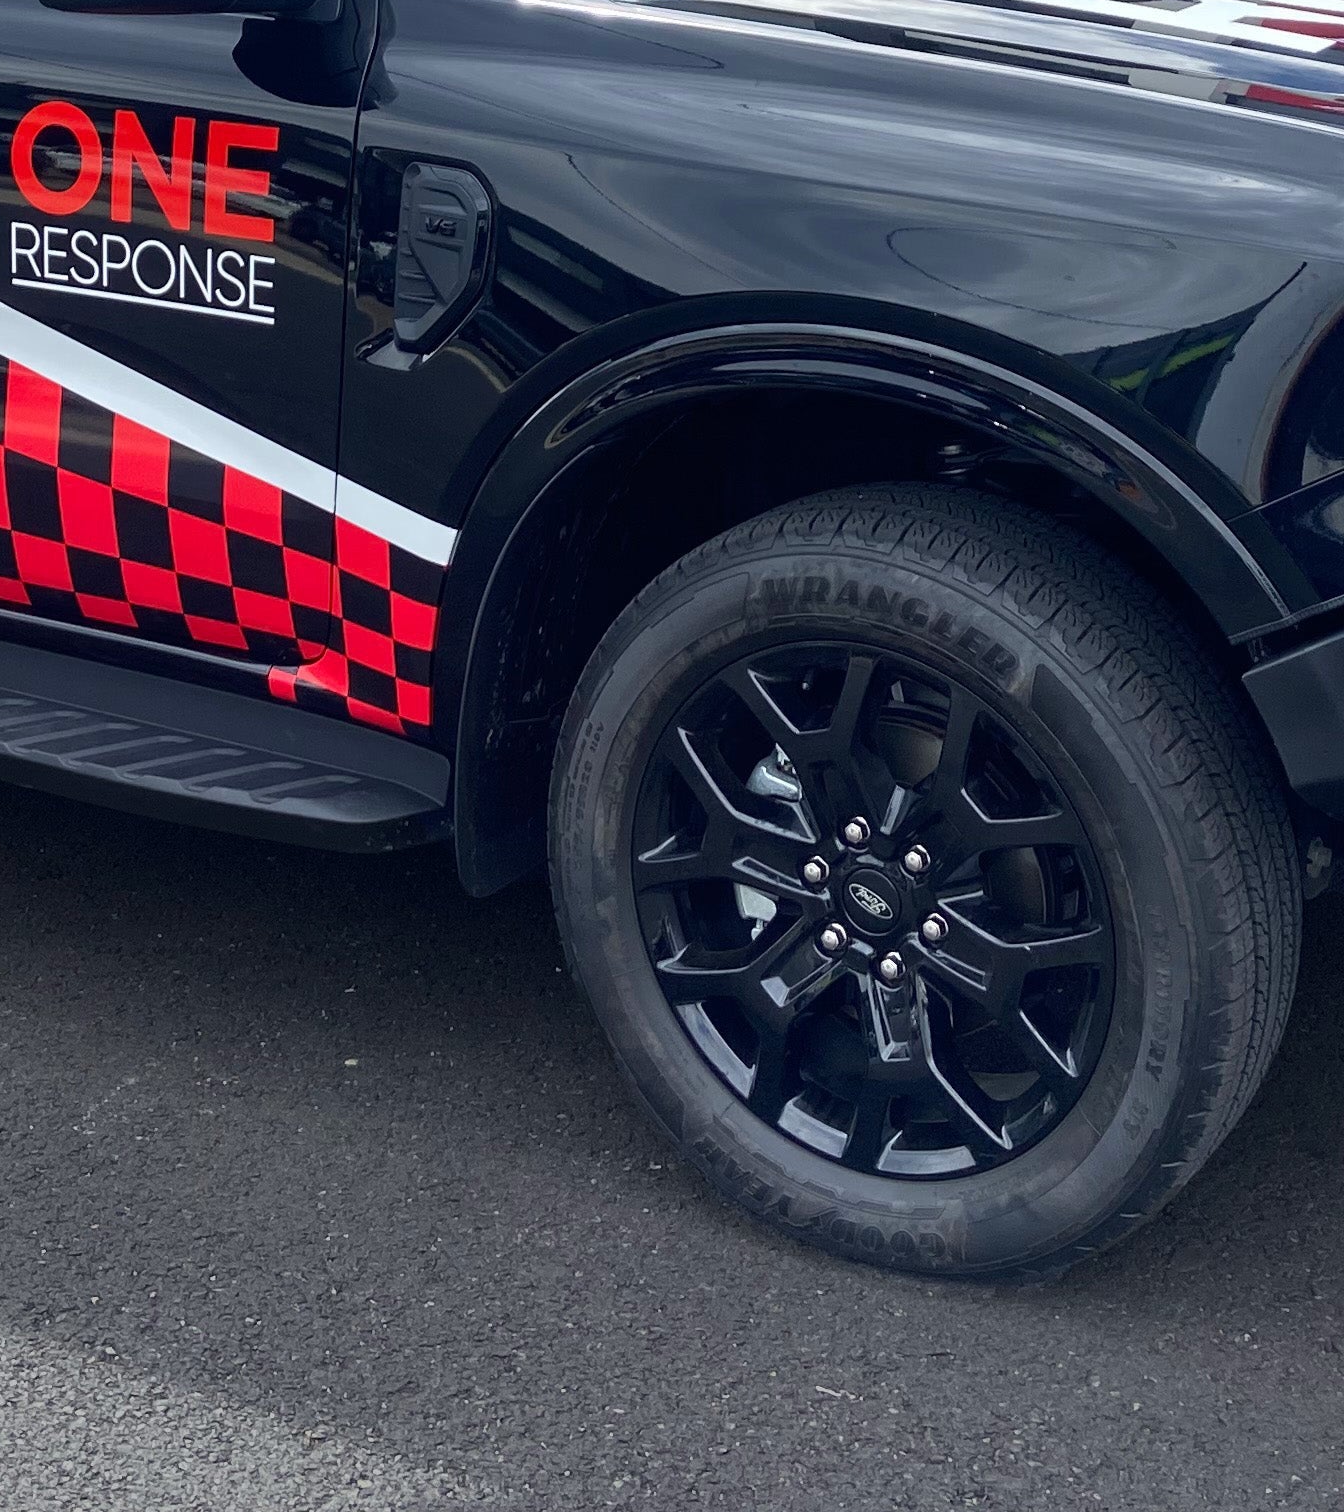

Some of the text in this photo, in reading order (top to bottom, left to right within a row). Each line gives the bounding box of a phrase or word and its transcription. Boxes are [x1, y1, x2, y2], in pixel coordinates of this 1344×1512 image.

[10, 100, 280, 243] ONE
[10, 221, 276, 315] RESPONSE
[755, 575, 1021, 679] WRANGLER
[855, 888, 887, 914] Ford
